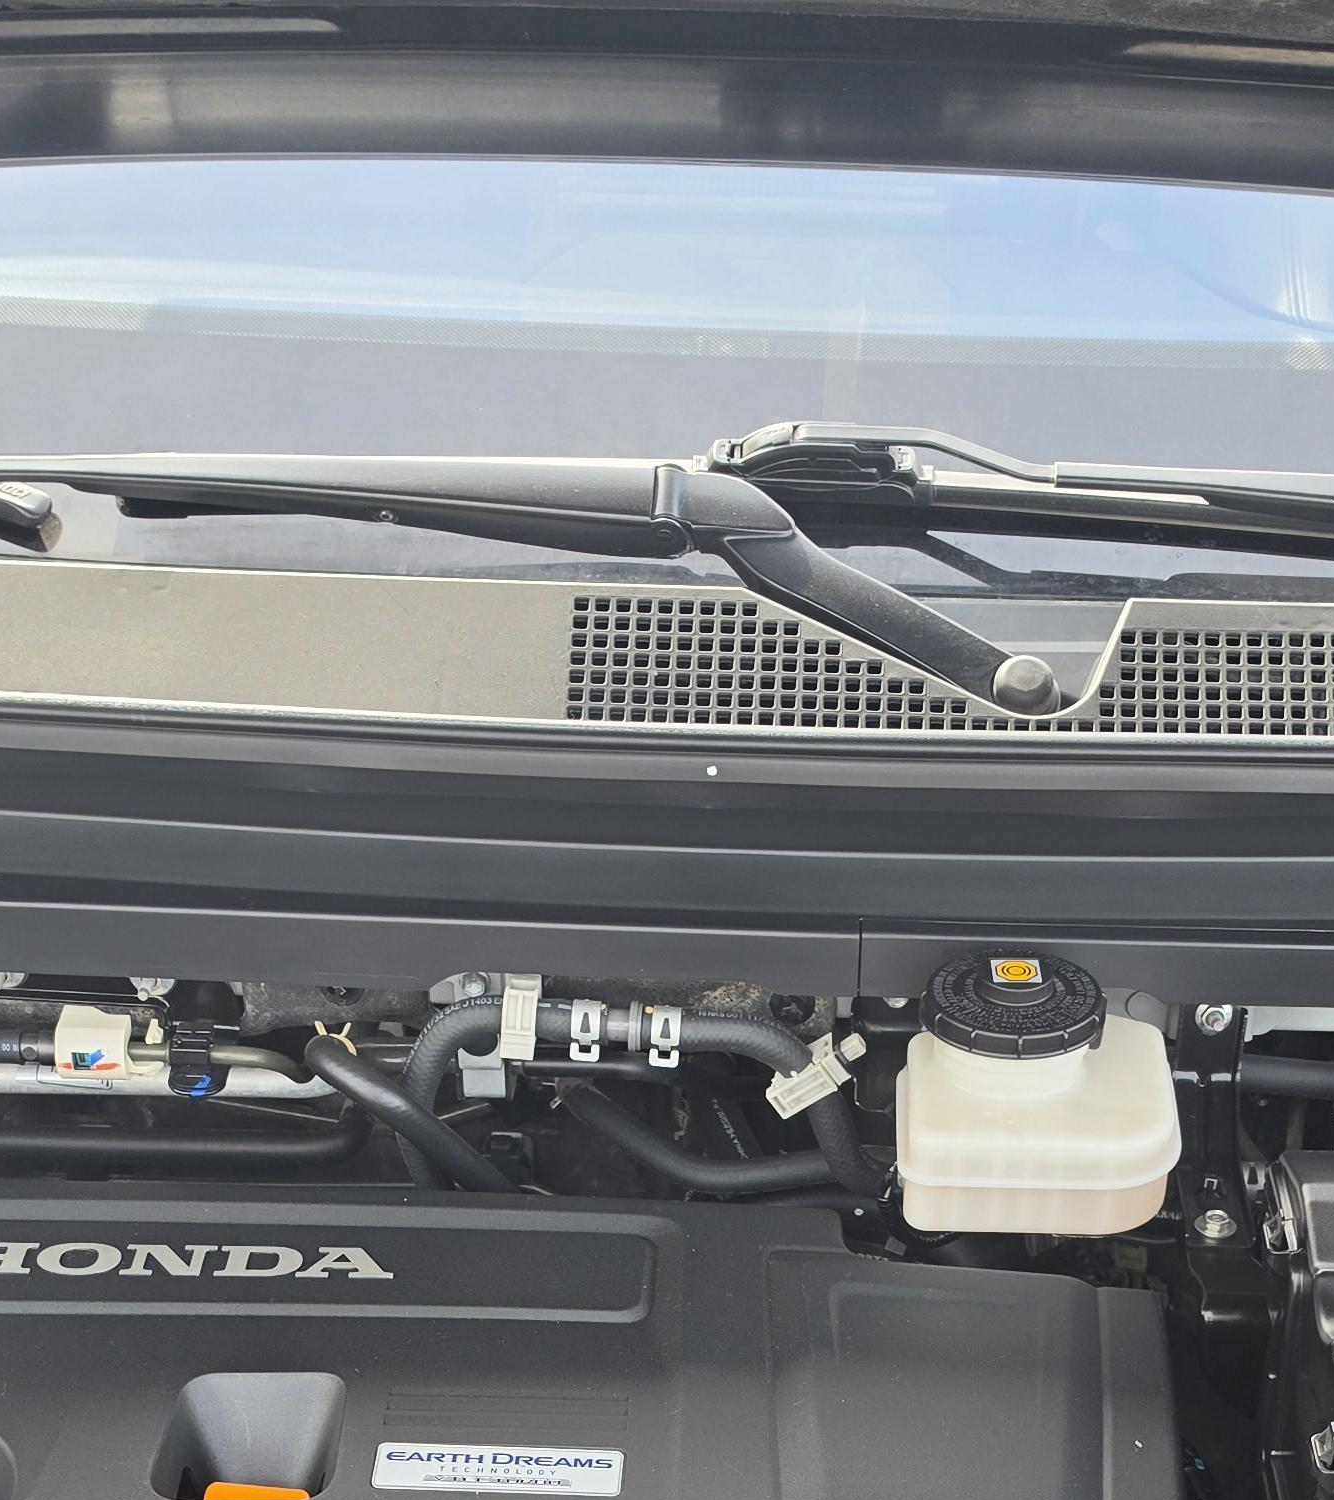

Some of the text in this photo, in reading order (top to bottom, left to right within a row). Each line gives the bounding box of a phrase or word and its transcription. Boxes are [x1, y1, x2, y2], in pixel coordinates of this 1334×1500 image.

[386, 1450, 614, 1470] EARTH DREAMS
[439, 1465, 558, 1477] TECHNOLOGY
